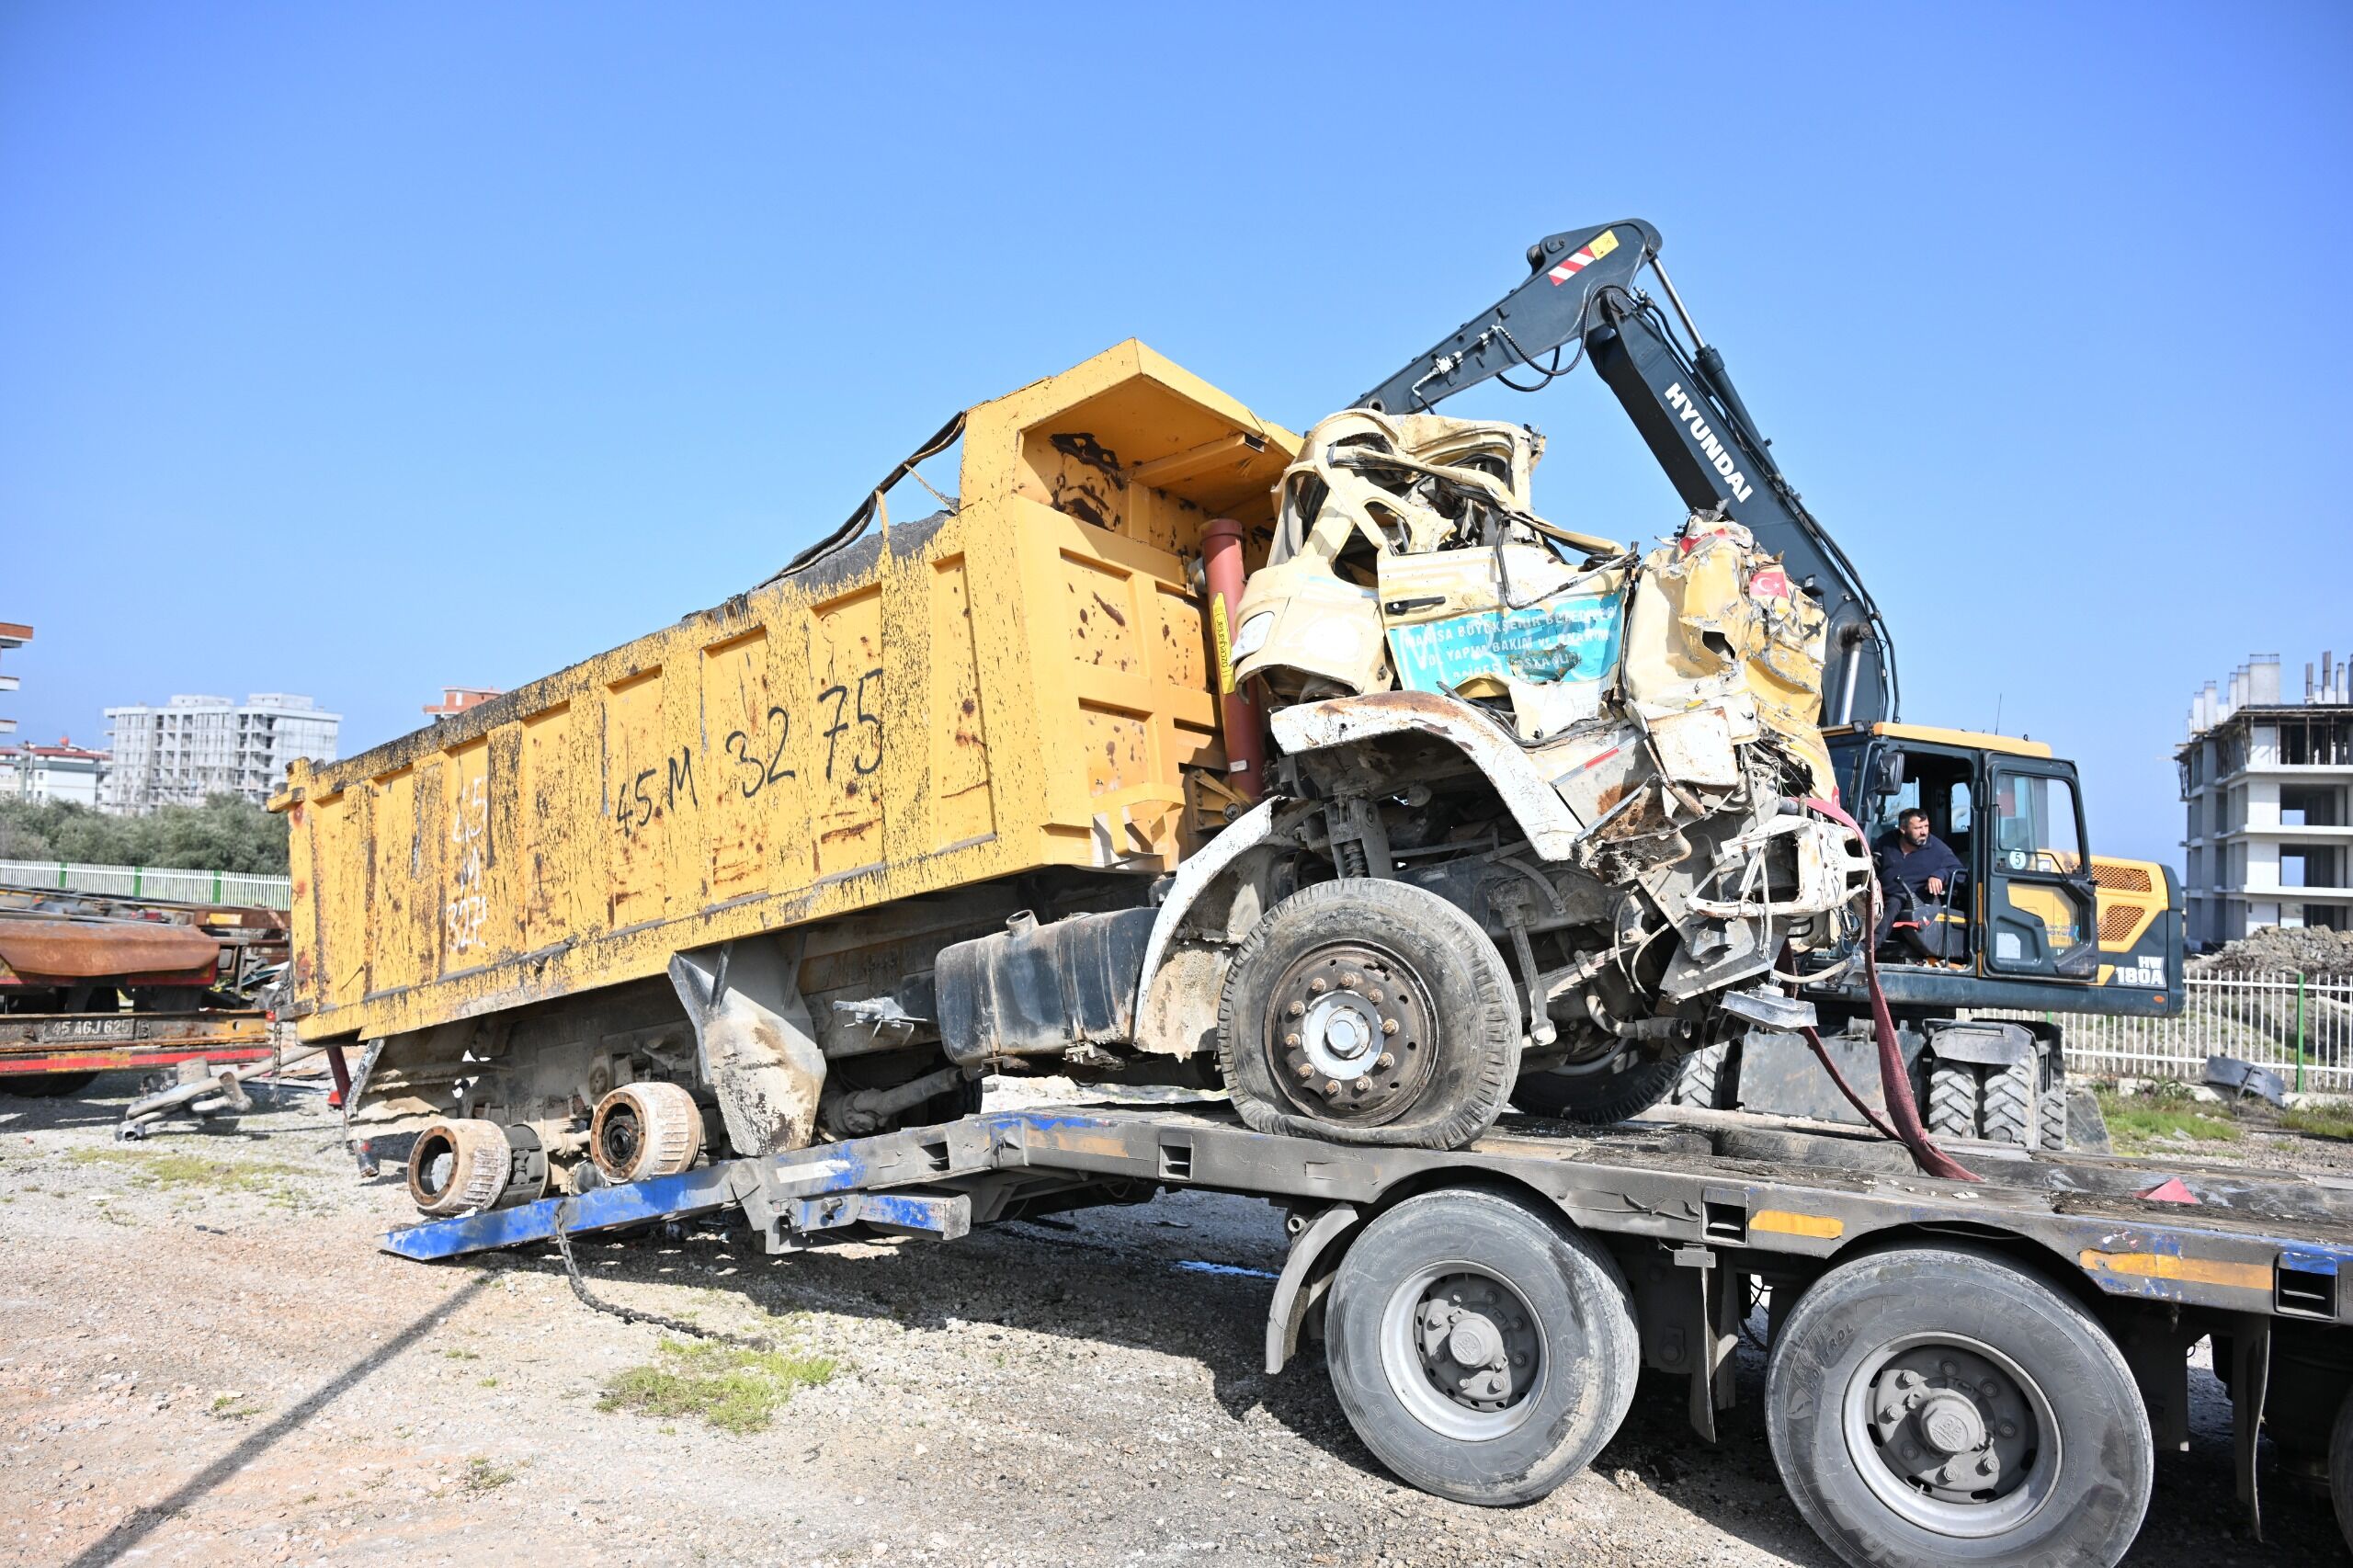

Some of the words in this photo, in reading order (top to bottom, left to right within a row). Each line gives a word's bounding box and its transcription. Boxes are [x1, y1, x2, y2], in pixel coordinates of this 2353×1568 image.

[1665, 382, 1753, 503] HYUNDAI
[1492, 636, 1533, 653] BAKIM
[616, 768, 656, 838] 45
[668, 746, 699, 812] M
[726, 706, 796, 798] 32
[817, 668, 883, 781] 75
[2015, 853, 2021, 865] 5
[460, 846, 481, 892] M
[2138, 956, 2163, 969] HW
[2116, 967, 2165, 985] 180A
[52, 1020, 71, 1036] 45
[74, 1020, 101, 1035] AGJ
[104, 1018, 130, 1033] 625
